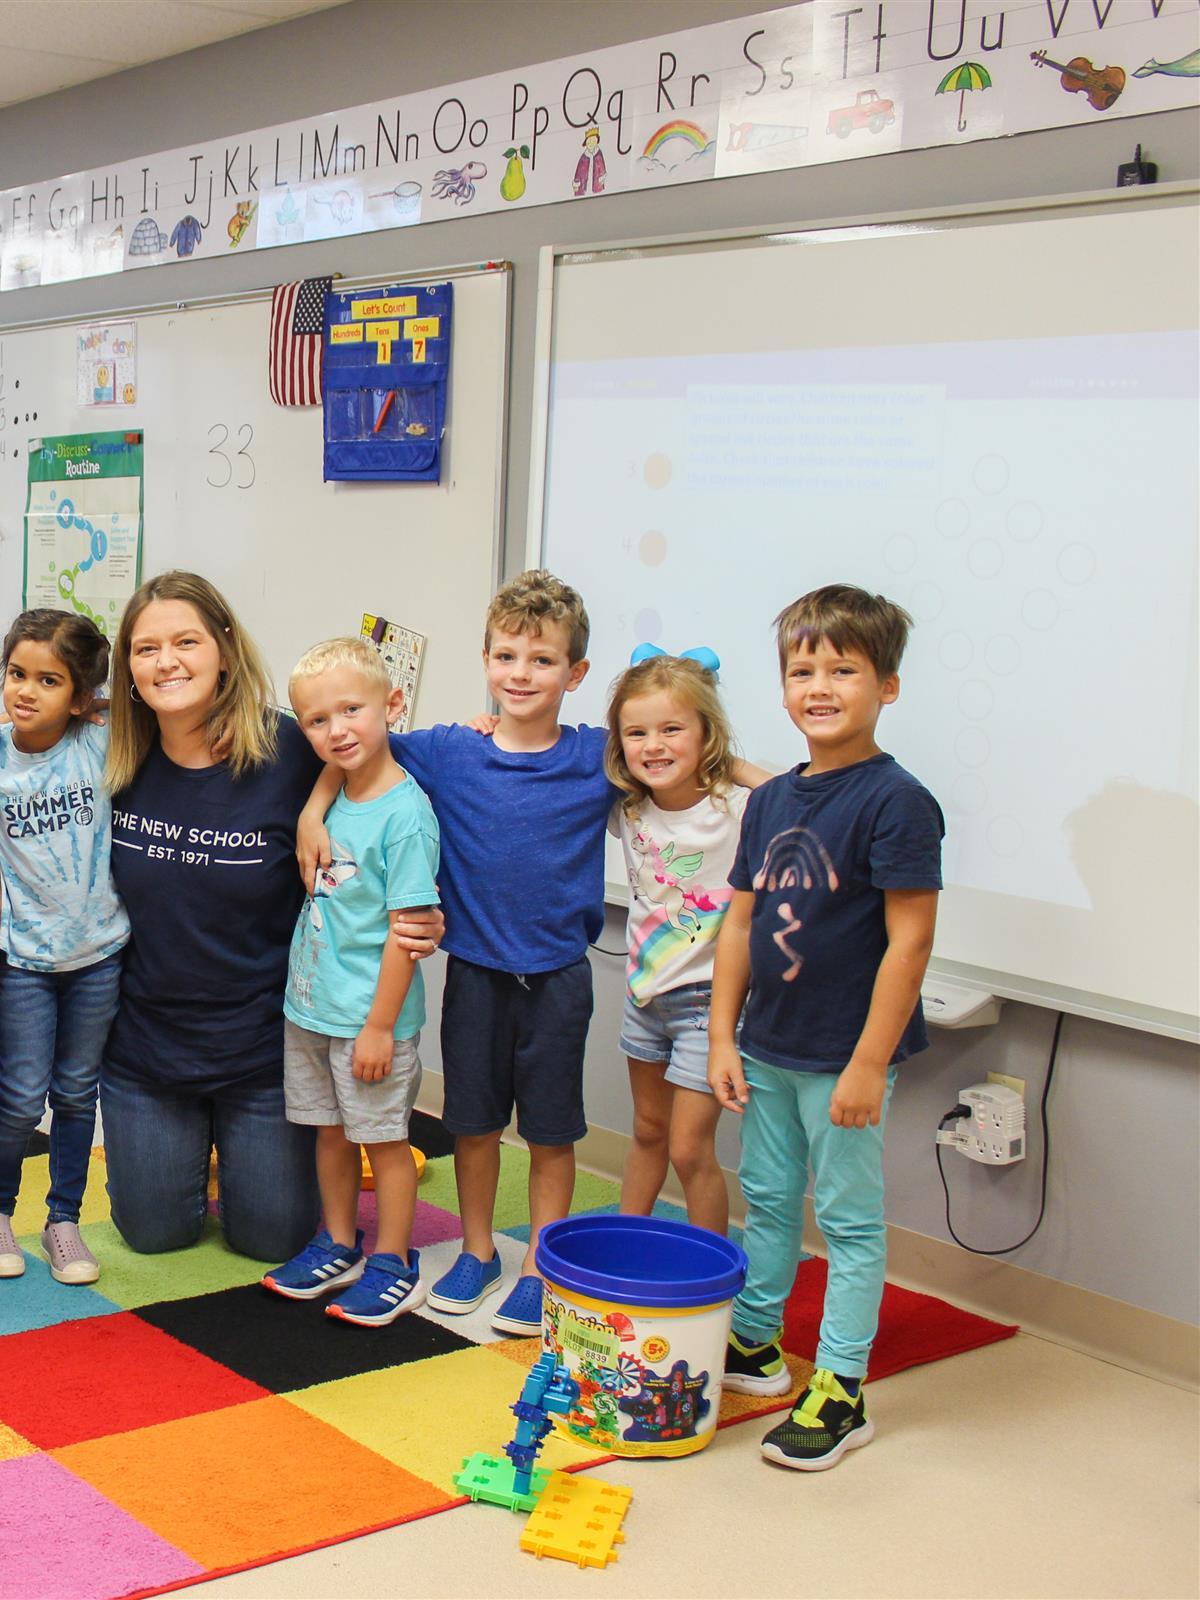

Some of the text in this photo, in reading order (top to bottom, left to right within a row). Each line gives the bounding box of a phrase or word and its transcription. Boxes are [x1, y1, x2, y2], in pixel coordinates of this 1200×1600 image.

[362, 302, 406, 316] Let's Count
[381, 341, 424, 361] 1 7
[206, 423, 256, 489] 33
[65, 459, 101, 478] Routine
[53, 779, 92, 796] SCHOOL
[4, 787, 94, 821] SUMMER
[6, 813, 71, 838] CAMP
[113, 810, 268, 848] THE NEW SCHOOL
[147, 844, 210, 866] EST. 1971
[585, 1350, 607, 1363] 8839
[649, 1343, 664, 1355] 5+
